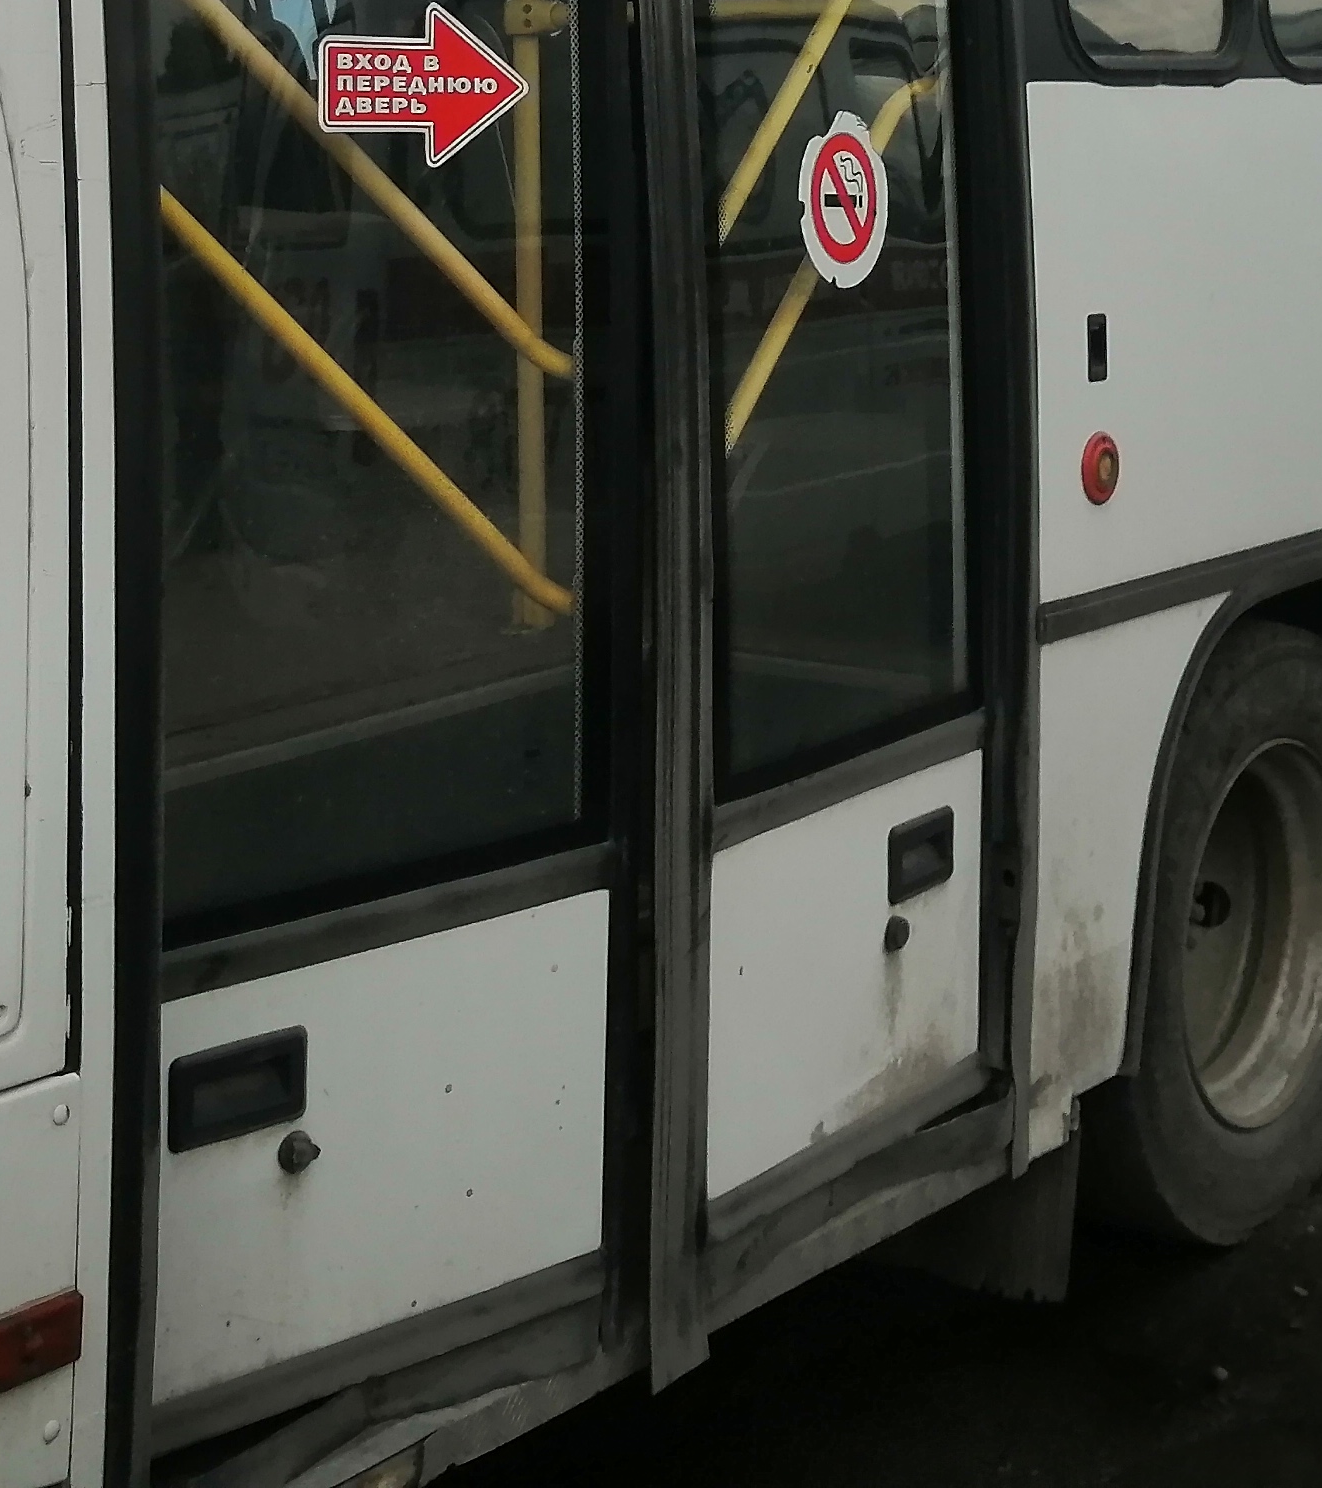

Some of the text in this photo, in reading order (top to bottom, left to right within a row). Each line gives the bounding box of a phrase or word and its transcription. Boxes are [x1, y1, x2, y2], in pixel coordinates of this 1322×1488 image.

[337, 53, 440, 74] ВХОД В
[337, 75, 498, 95] ПЕРЕДНЮЮ
[335, 97, 427, 116] ДВЕРЬ
